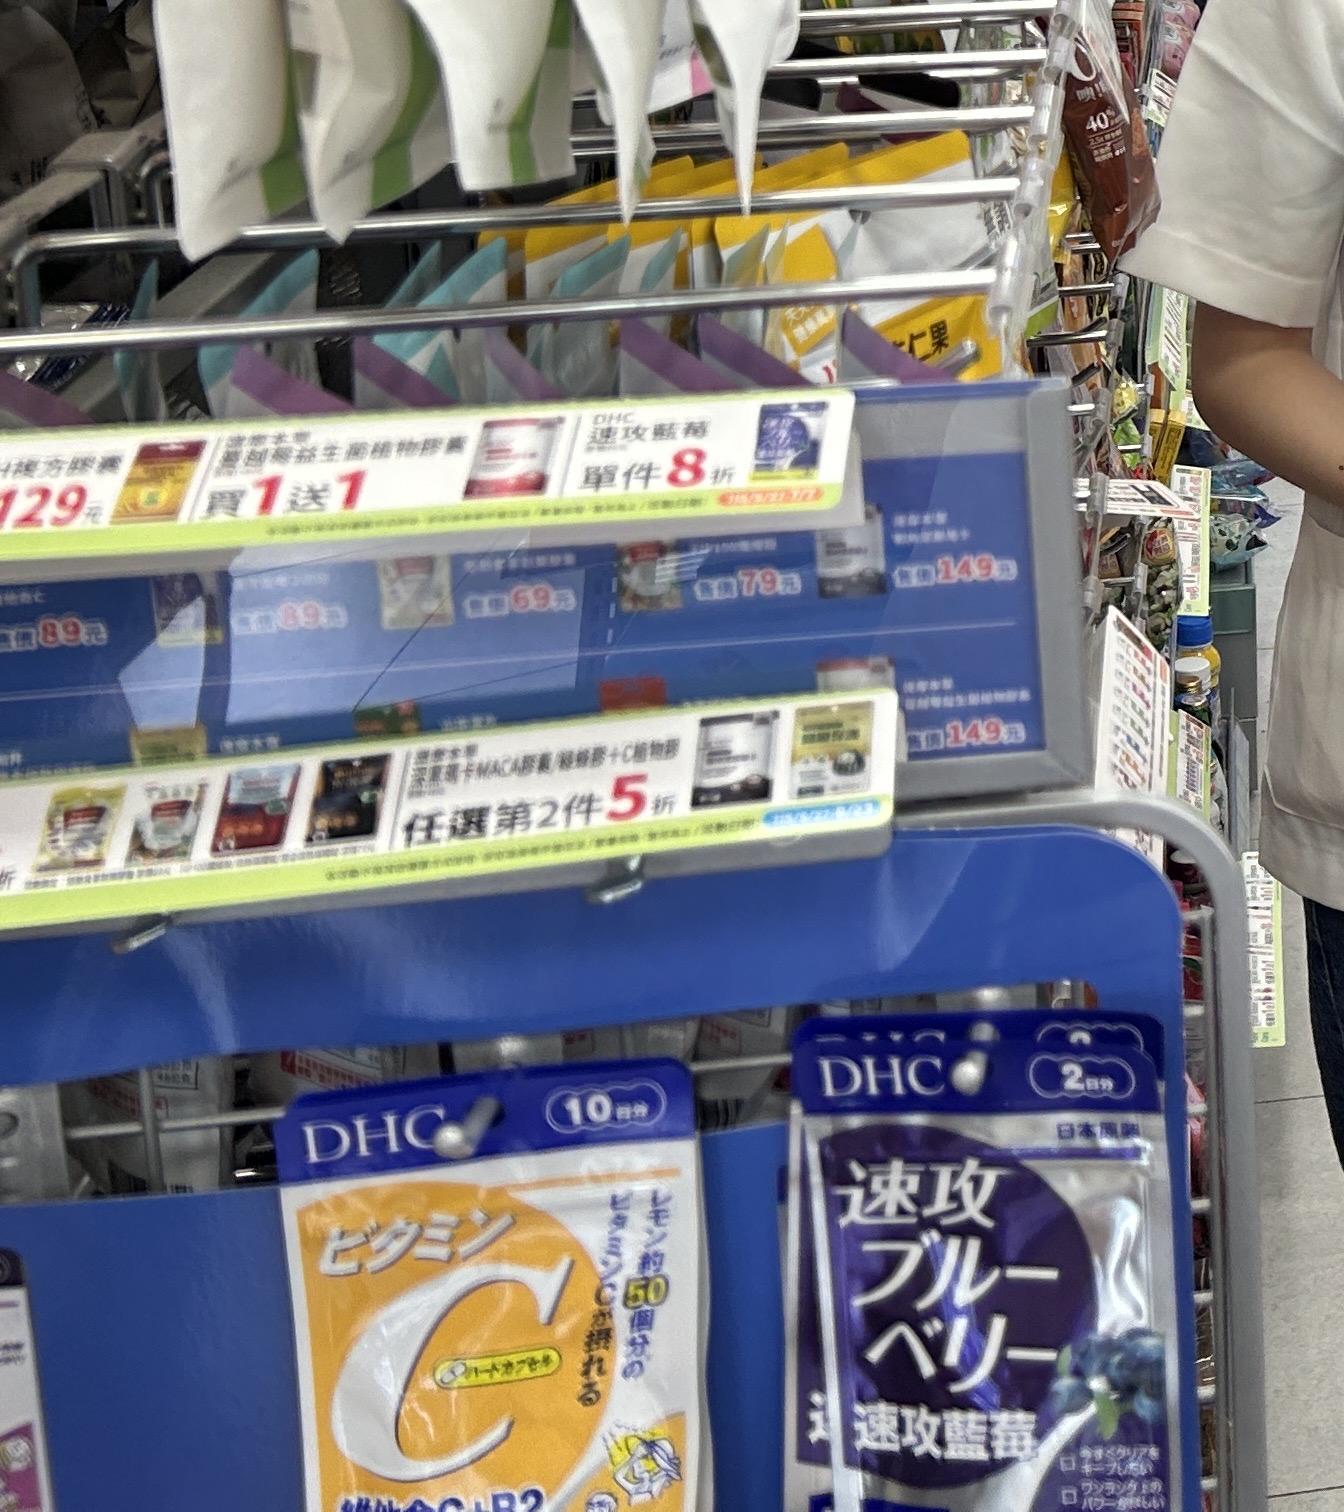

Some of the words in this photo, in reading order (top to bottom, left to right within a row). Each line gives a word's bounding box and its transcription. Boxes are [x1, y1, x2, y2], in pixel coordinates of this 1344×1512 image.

[205, 468, 368, 517] 買1送1
[577, 447, 738, 493] 單件8折
[403, 773, 677, 848] 任選第2件5折
[818, 1054, 946, 1098] DHC
[1062, 1063, 1115, 1092] 2日分
[303, 1105, 448, 1165] DHC
[562, 1093, 648, 1128] 10日分
[837, 1157, 1000, 1228] 速攻
[320, 1208, 515, 1277] ビタミン
[852, 1229, 1060, 1311] ブルー
[331, 1256, 575, 1482] C
[864, 1313, 1058, 1393] ベリー
[855, 1405, 1038, 1462] 速攻藍莓
